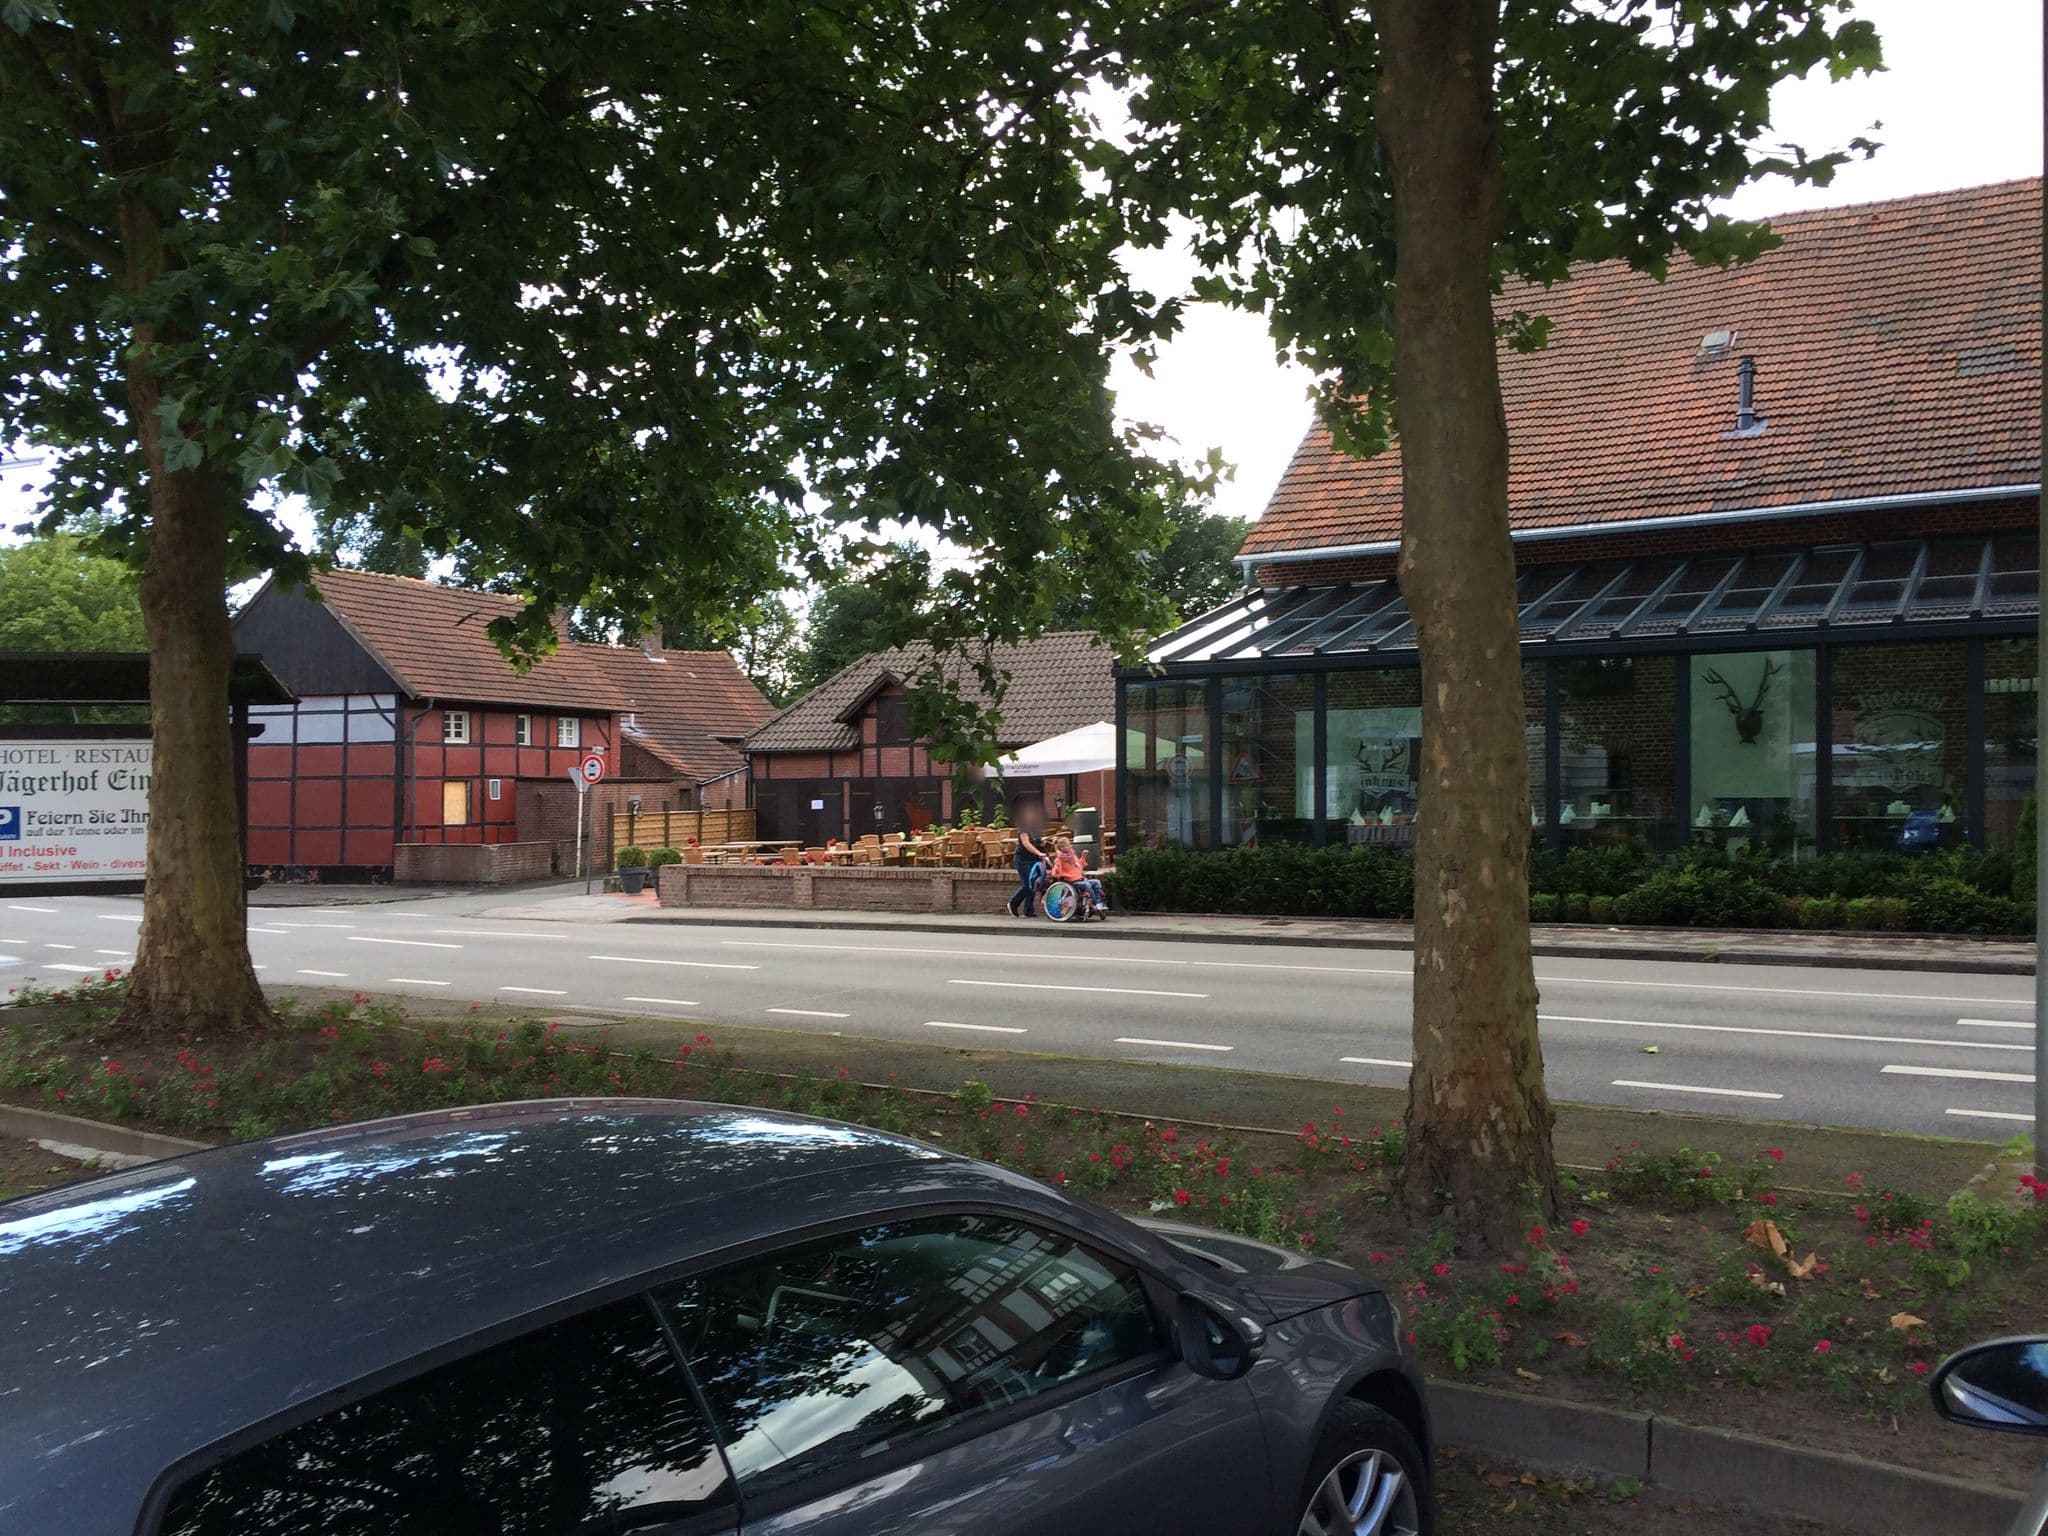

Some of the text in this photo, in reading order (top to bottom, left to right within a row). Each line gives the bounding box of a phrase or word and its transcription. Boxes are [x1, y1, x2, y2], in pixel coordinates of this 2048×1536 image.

[26, 810, 83, 825] Feiern
[88, 809, 116, 824] Sie
[46, 826, 65, 836] der
[8, 844, 77, 858] Inclusive
[34, 860, 60, 871] Sekt
[70, 859, 100, 870] Wein
